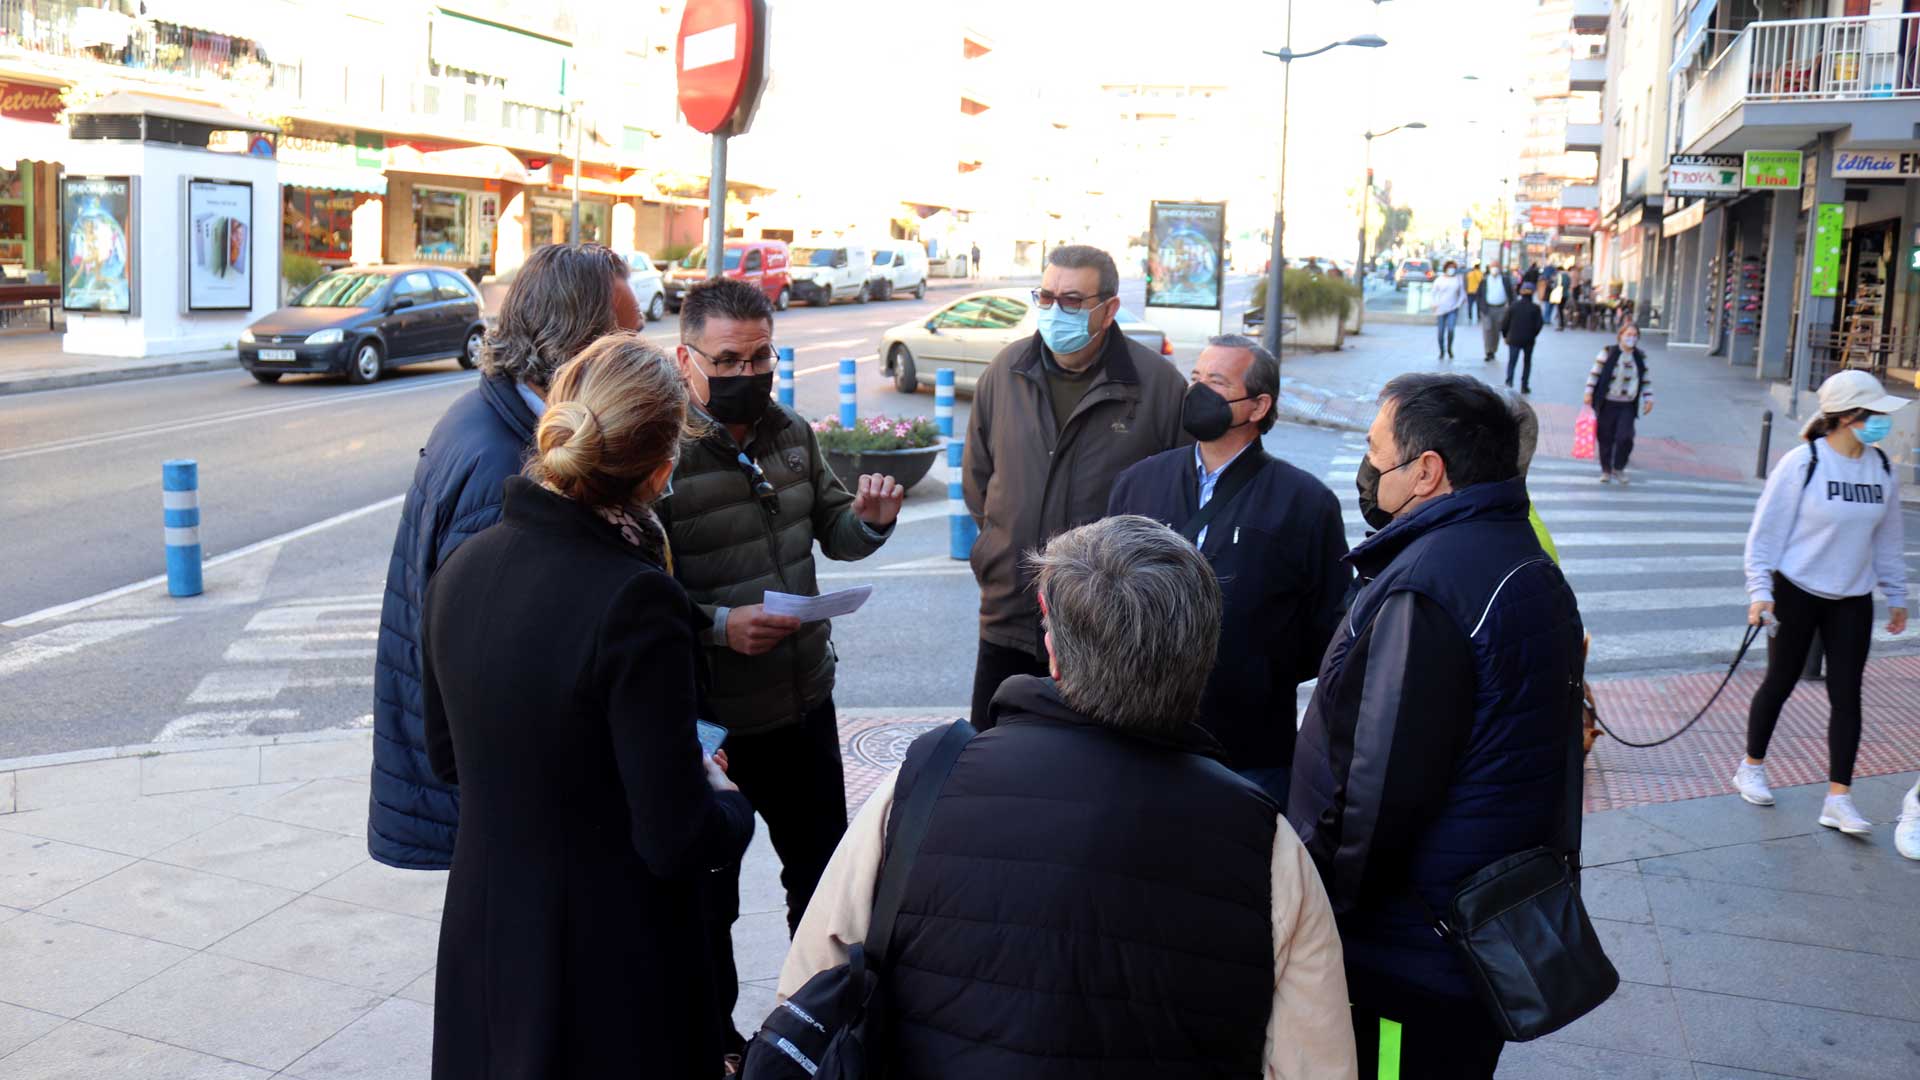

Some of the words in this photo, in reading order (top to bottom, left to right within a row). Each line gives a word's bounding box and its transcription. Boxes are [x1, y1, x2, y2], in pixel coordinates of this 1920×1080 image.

[1672, 155, 1740, 166] CALZADOS
[1836, 153, 1895, 172] Edificio
[1756, 174, 1789, 186] Fina
[1827, 480, 1884, 504] PUMA
